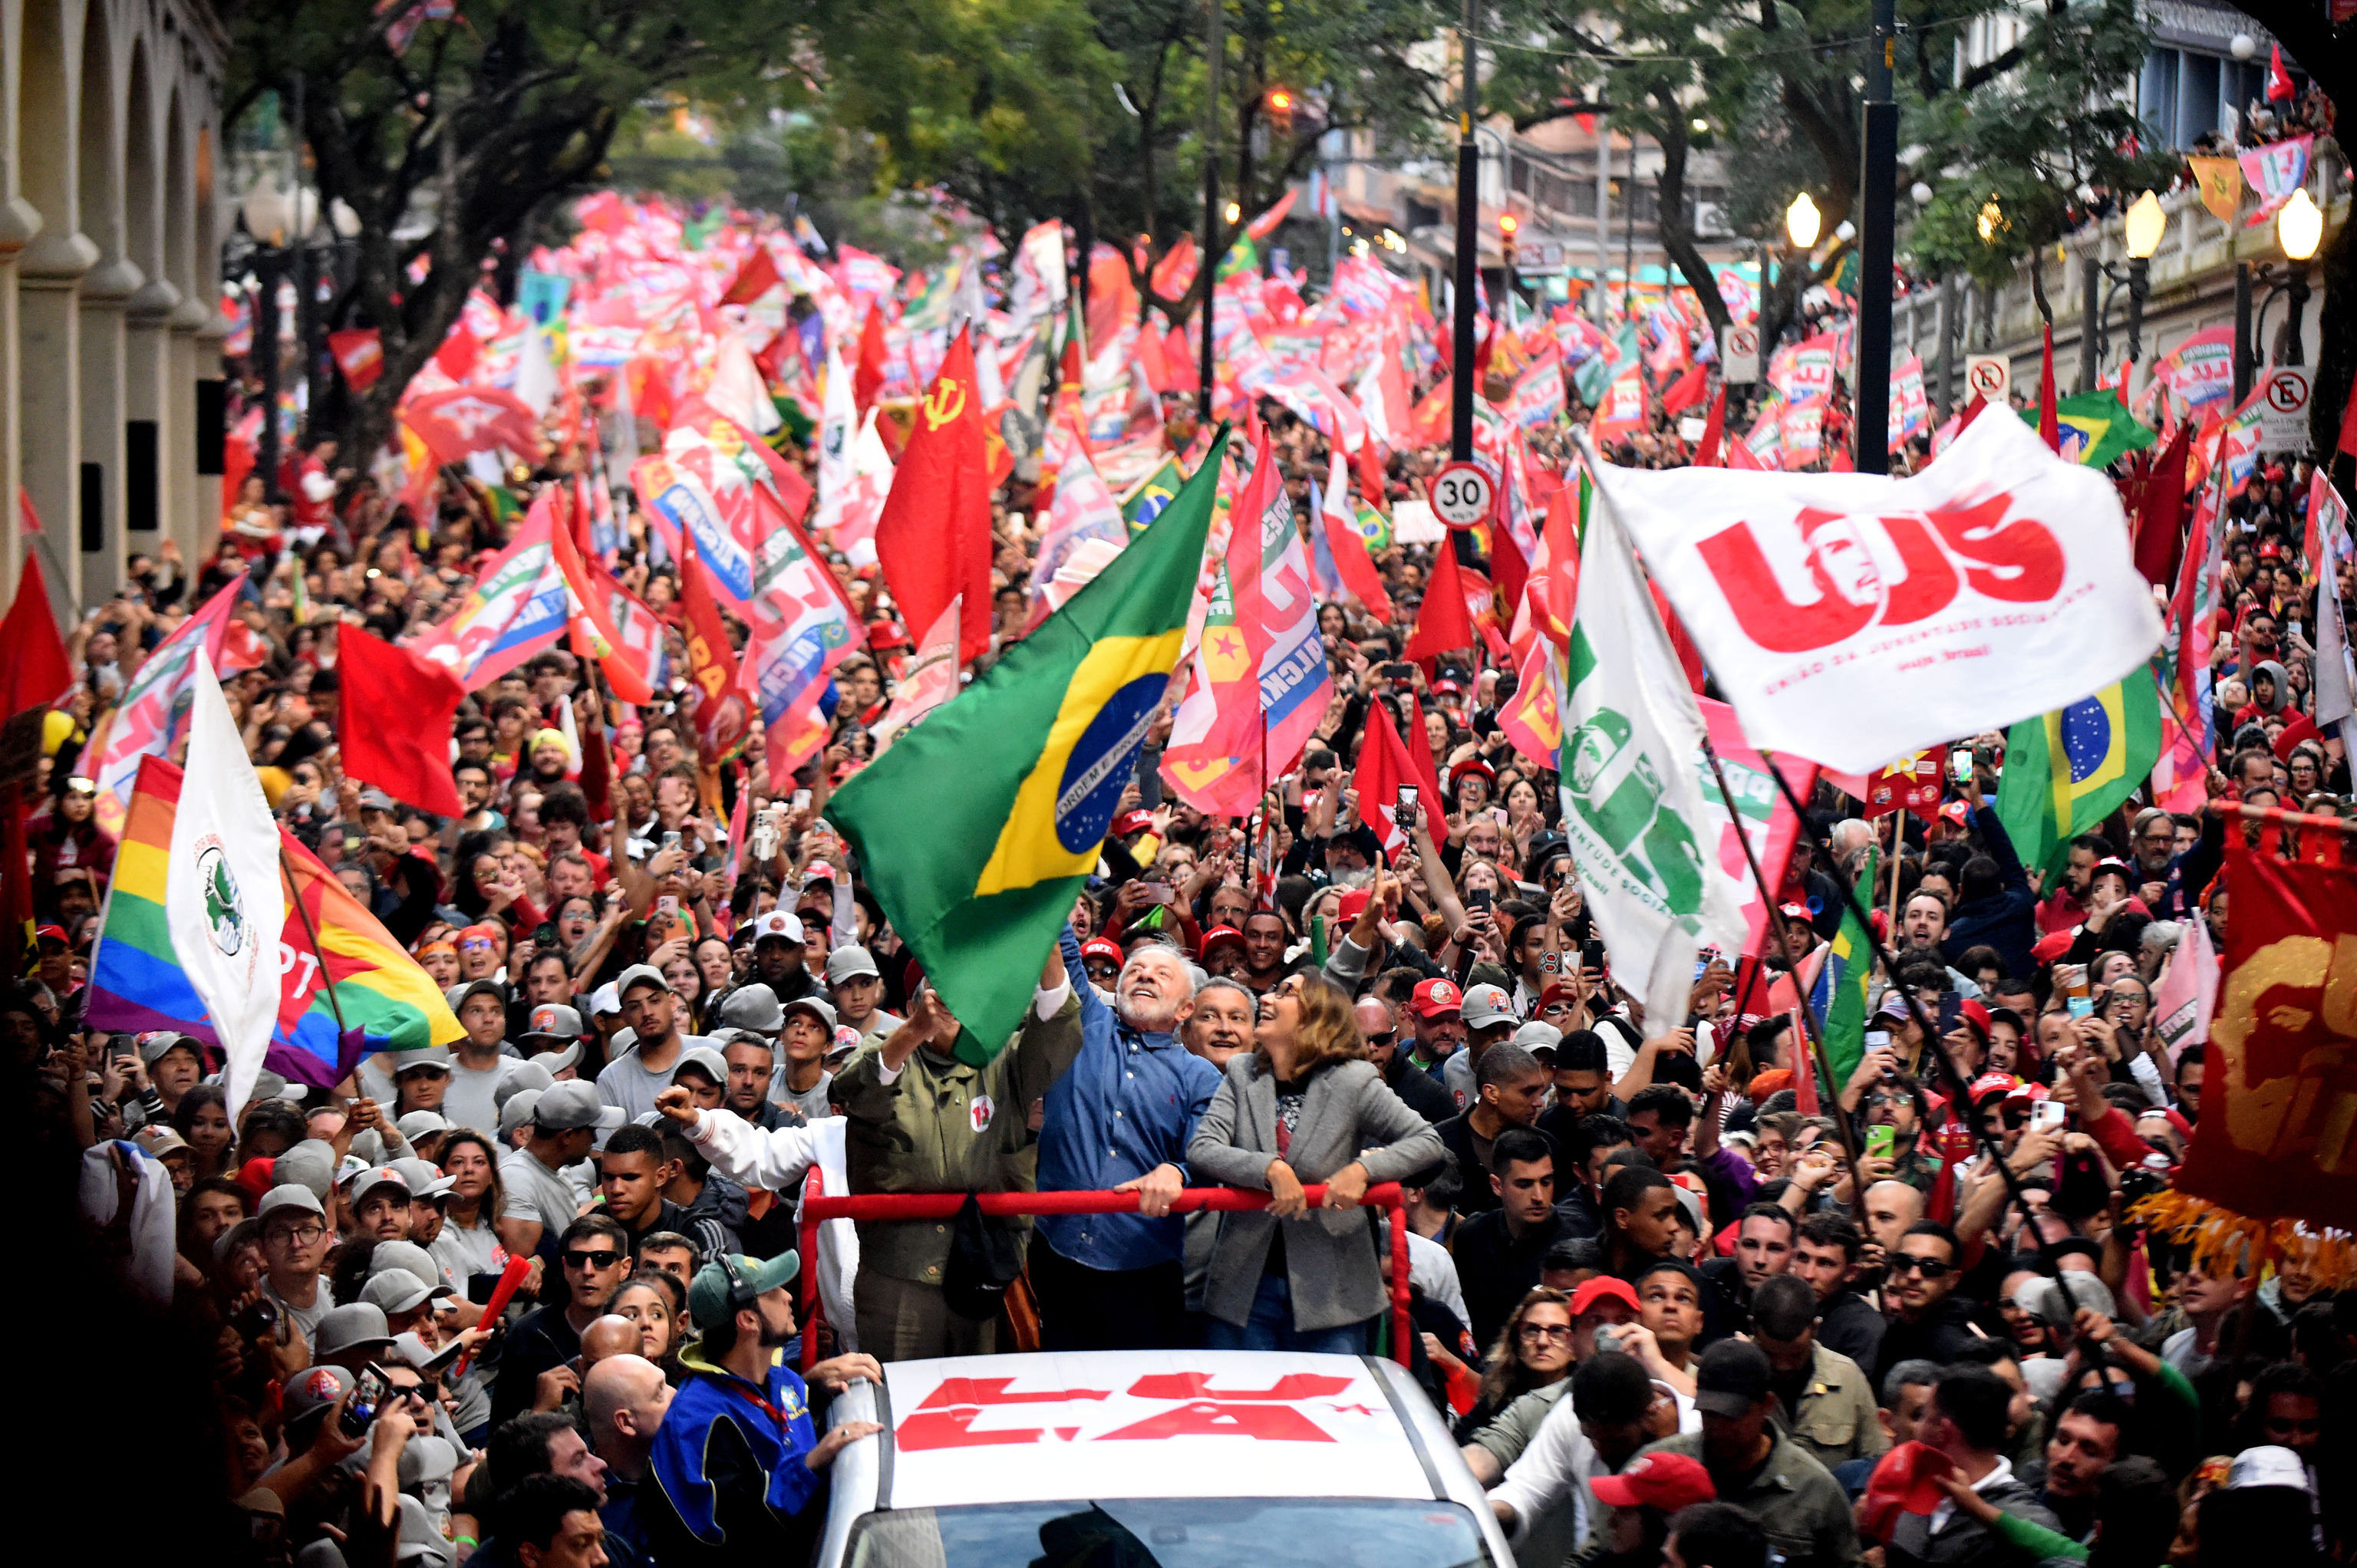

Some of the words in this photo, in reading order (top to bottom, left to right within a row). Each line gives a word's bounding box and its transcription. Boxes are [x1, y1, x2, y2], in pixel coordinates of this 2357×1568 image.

[2280, 380, 2295, 404] E
[1442, 479, 1480, 506] 30
[1058, 767, 1100, 815] ORDEM
